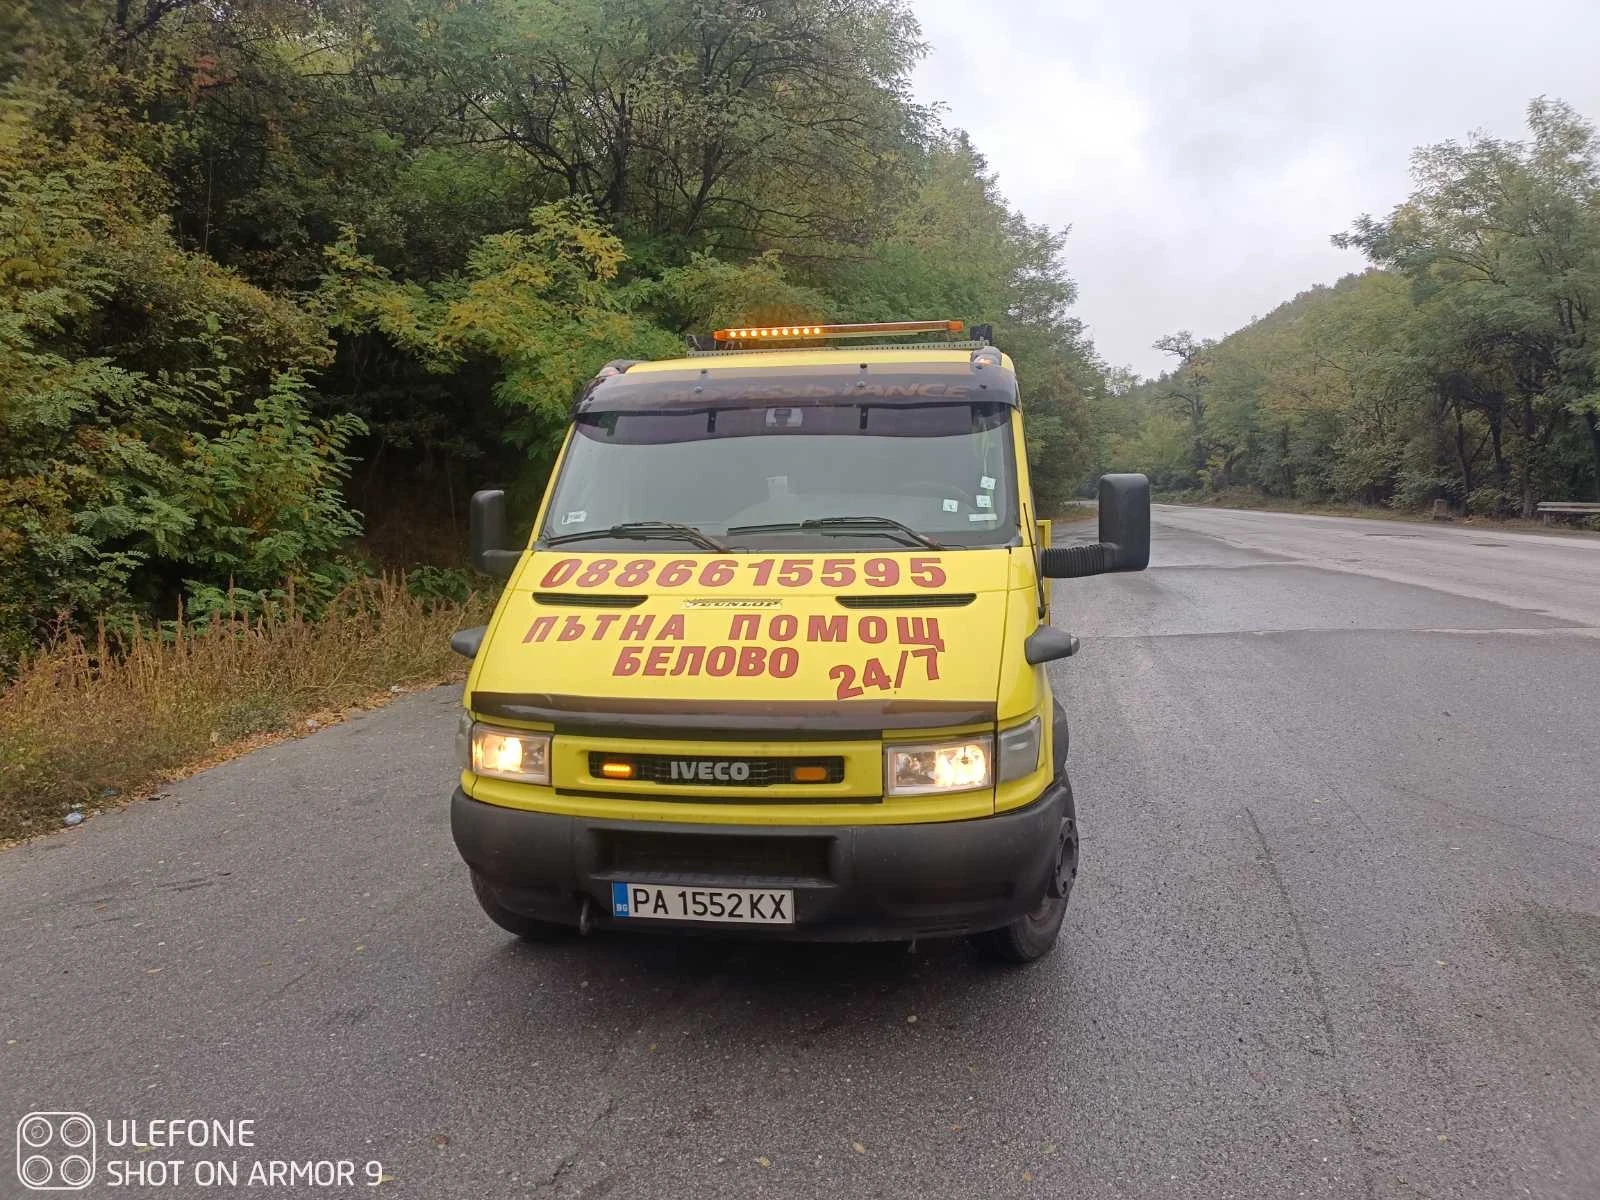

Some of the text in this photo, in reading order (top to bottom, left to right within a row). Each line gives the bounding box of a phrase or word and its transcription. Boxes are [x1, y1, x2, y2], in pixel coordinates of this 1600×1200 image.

[539, 558, 947, 588] 0886615595
[522, 614, 945, 652] ПЪТНА ПОМОЩ
[612, 645, 800, 678] БЕЛОВО
[828, 648, 940, 700] 24/7
[670, 760, 750, 781] IVECO
